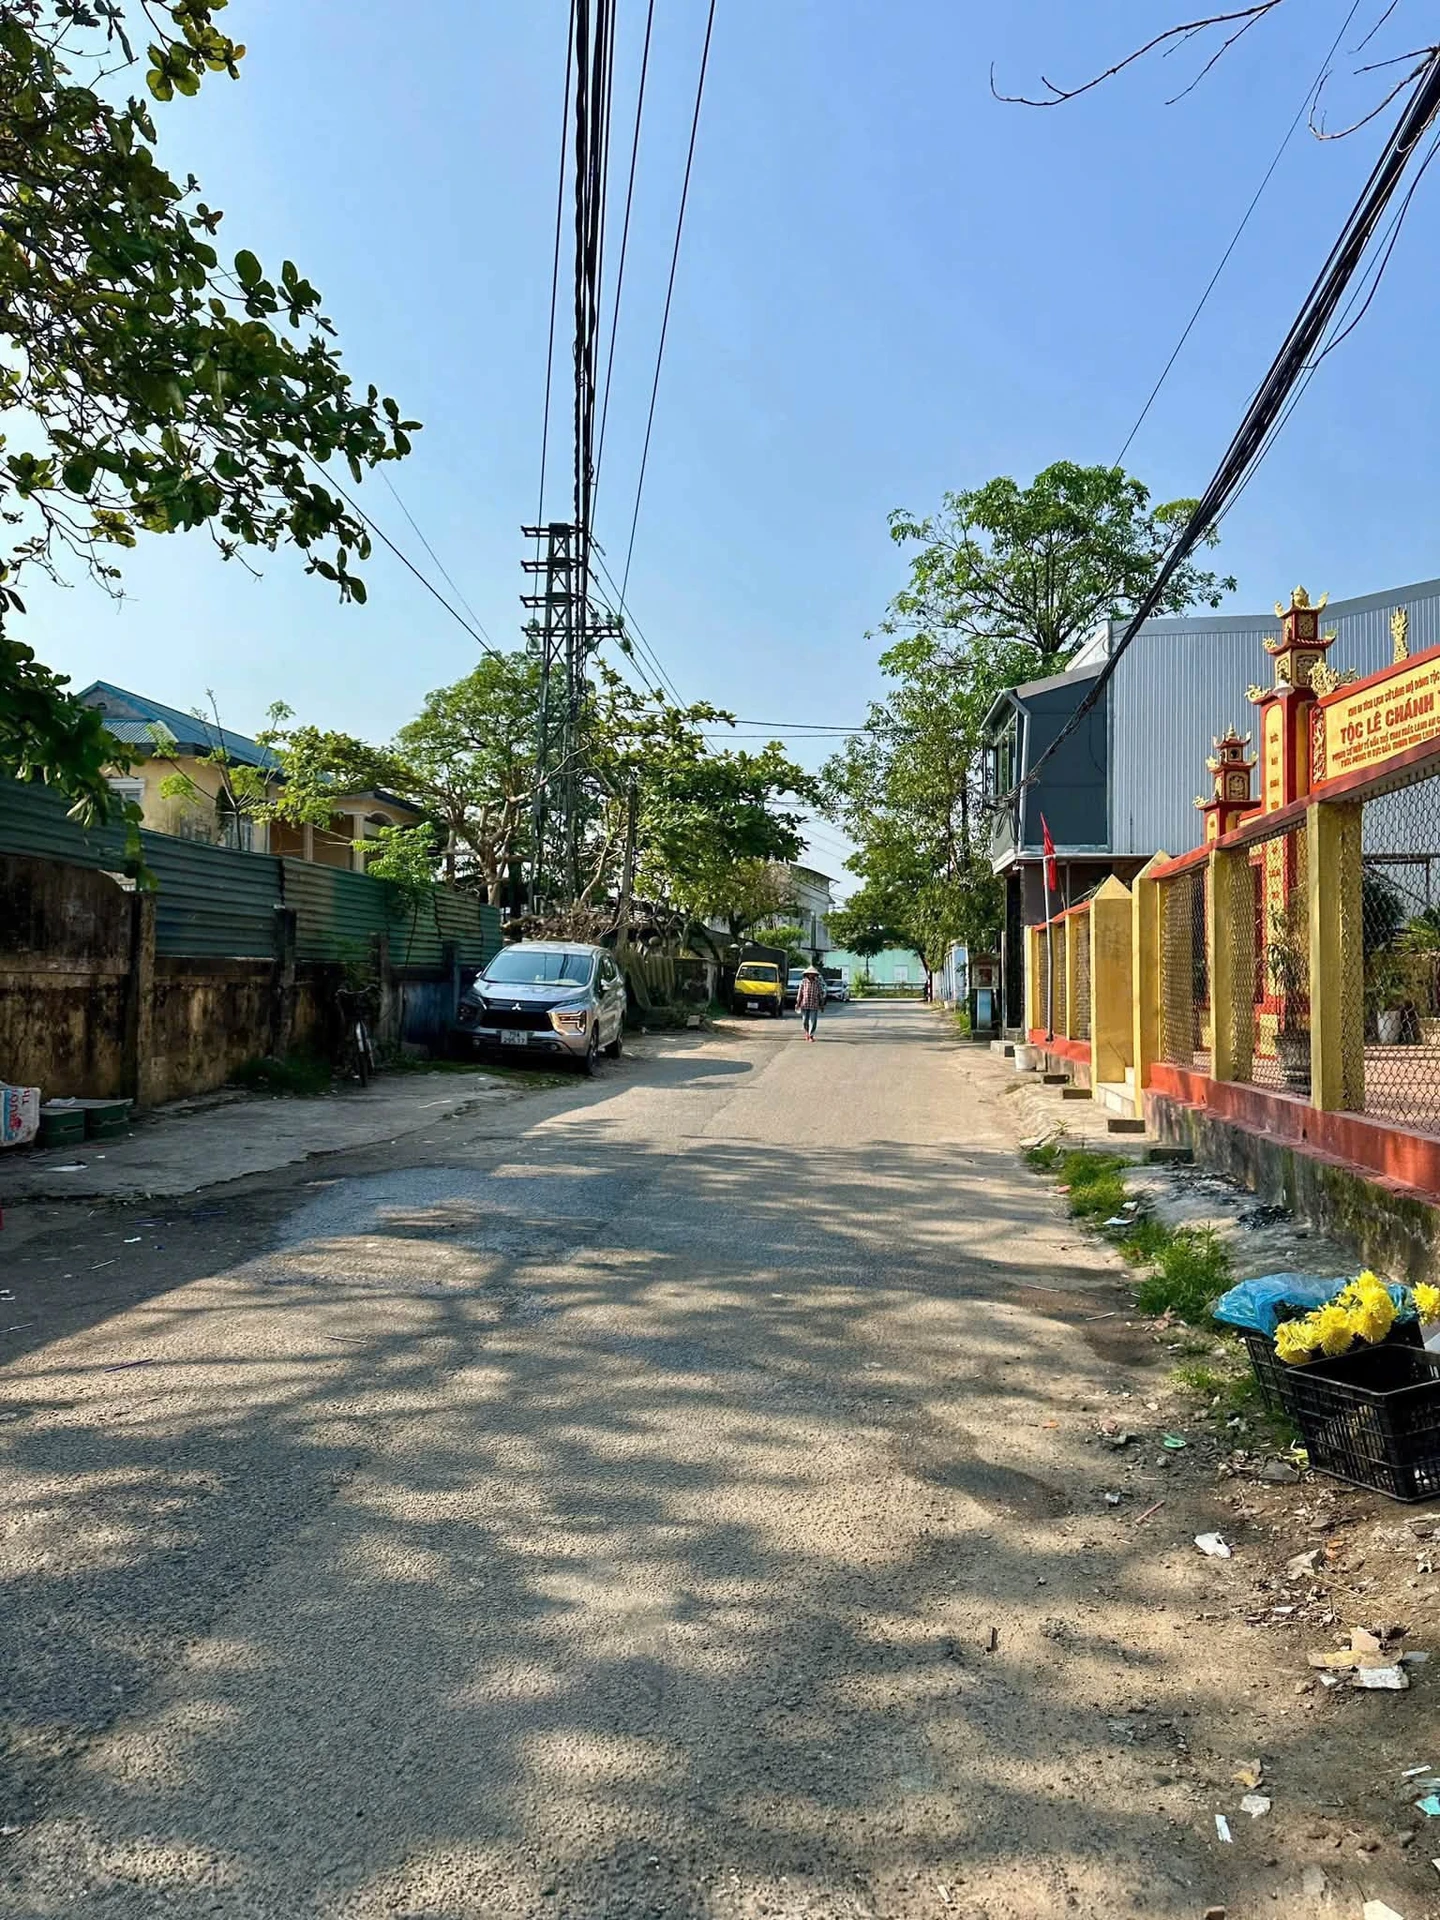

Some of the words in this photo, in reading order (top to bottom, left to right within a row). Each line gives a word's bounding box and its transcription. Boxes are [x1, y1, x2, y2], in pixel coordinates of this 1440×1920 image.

[1340, 721, 1364, 745] TỘC
[1367, 711, 1382, 735] LÊ
[1385, 692, 1434, 727] CHÁNH
